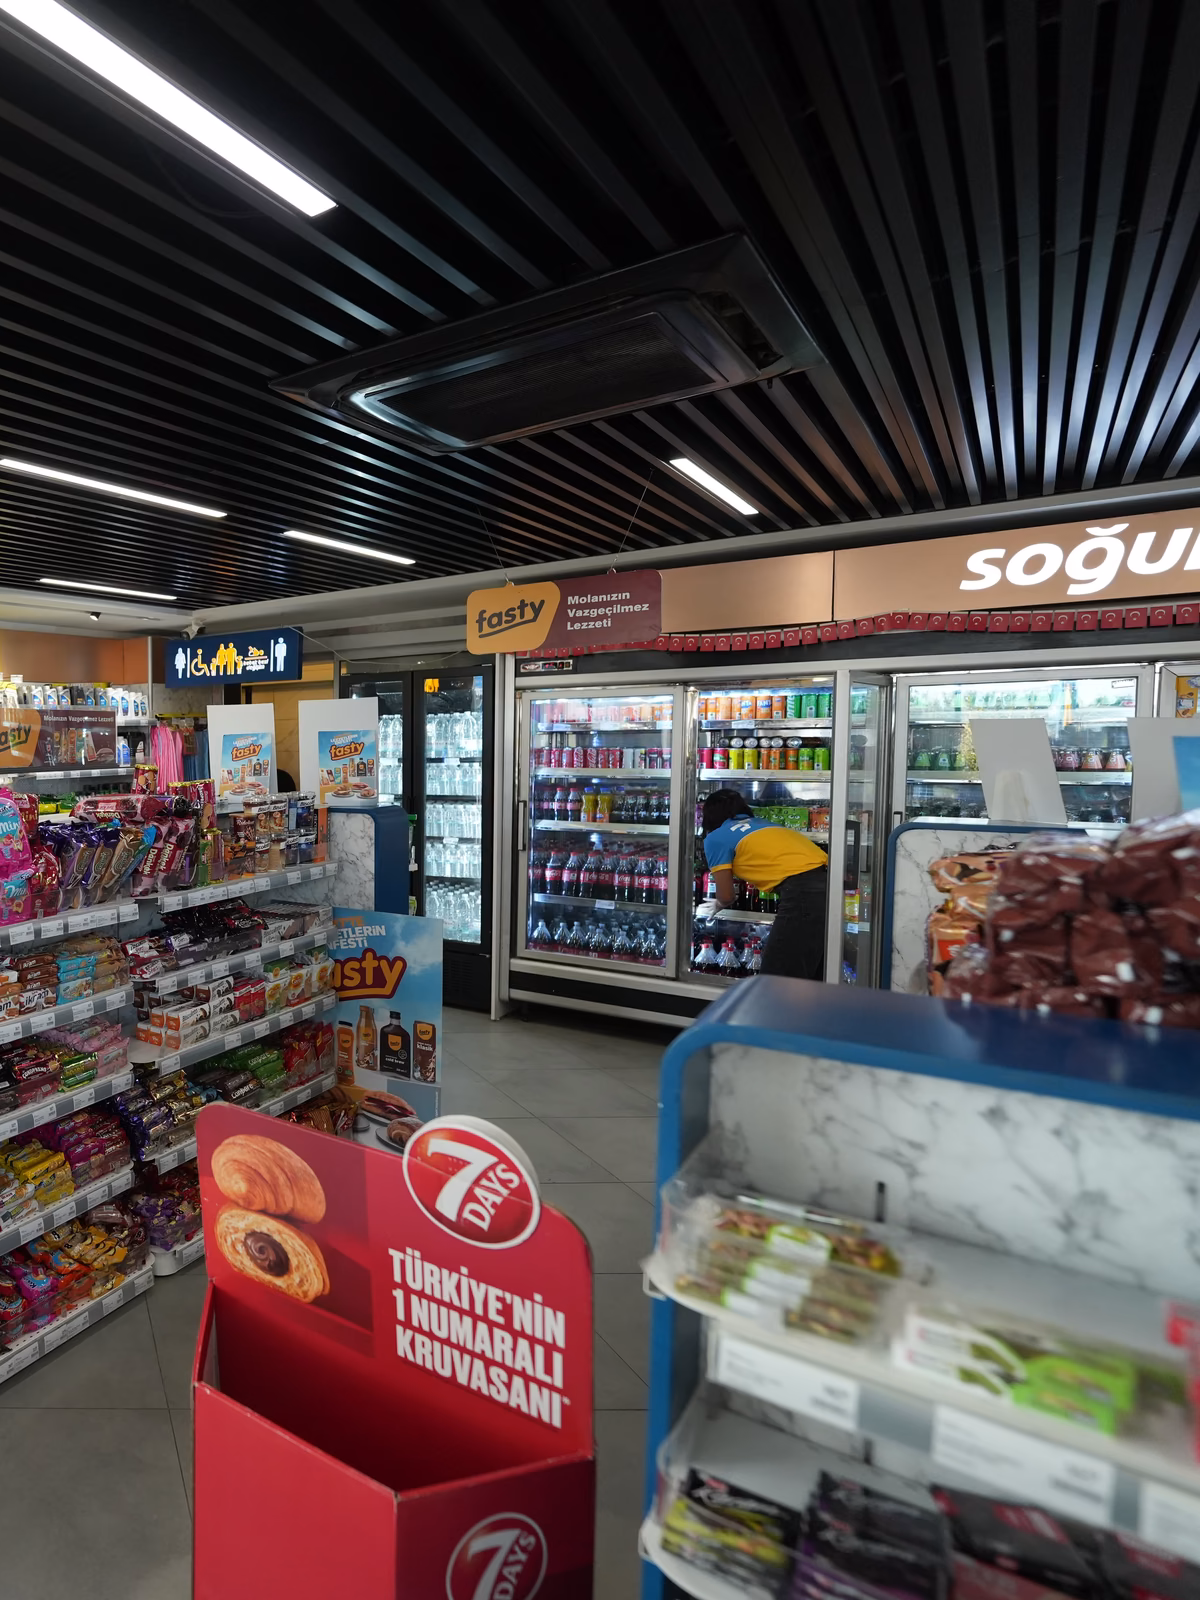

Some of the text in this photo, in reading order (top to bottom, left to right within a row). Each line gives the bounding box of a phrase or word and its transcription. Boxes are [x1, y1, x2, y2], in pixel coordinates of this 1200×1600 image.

[567, 591, 631, 605] Molanızın
[476, 599, 545, 638] fasty
[567, 603, 650, 618] Vazgeçilmez
[567, 618, 612, 631] Lezzeti
[232, 744, 262, 761] fasty
[330, 742, 364, 760] fasty
[25, 989, 49, 1006] ikram
[427, 1138, 521, 1232] 7 DAYS
[388, 1246, 566, 1349] TÜRKİYE'NİN
[392, 1288, 563, 1389] 1 NUMARALI
[467, 1528, 536, 1600] 7 DAYS
